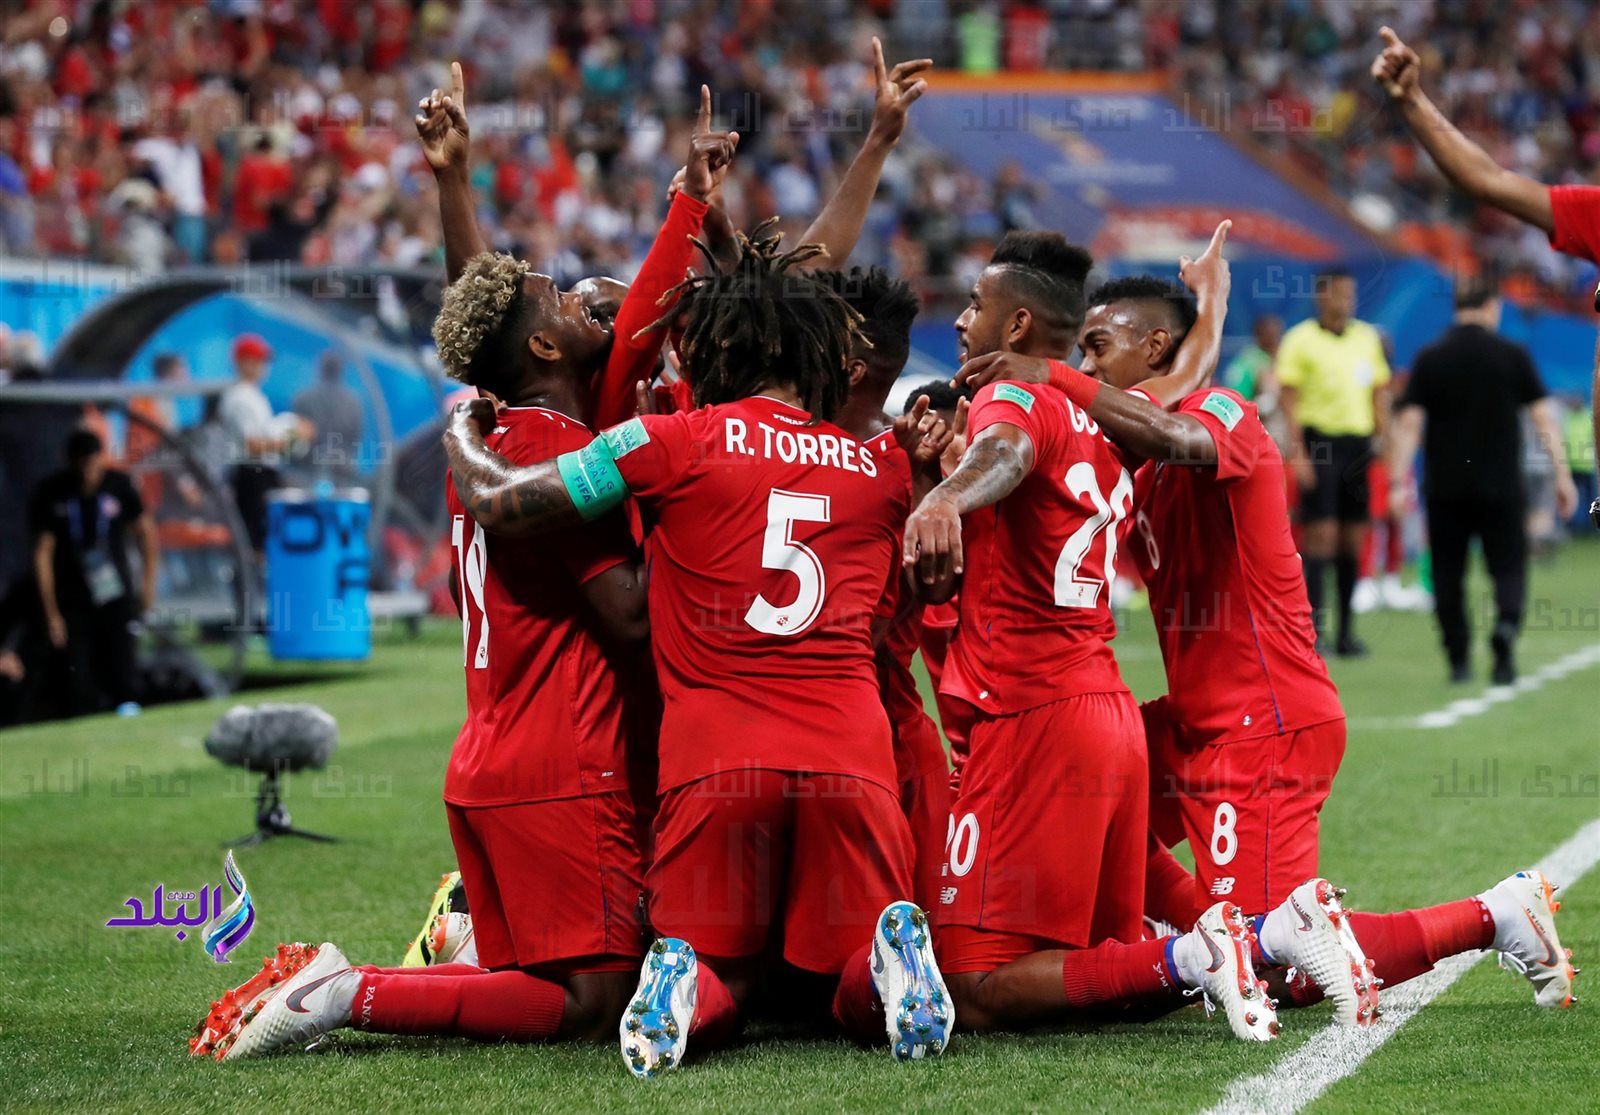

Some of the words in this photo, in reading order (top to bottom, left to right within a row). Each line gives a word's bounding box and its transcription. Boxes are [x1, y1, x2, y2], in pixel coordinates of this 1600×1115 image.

[574, 475, 592, 504] FIFA
[451, 515, 490, 669] 19
[744, 488, 831, 637] 5
[1210, 801, 1239, 866] 8
[361, 986, 377, 1027] PANA
